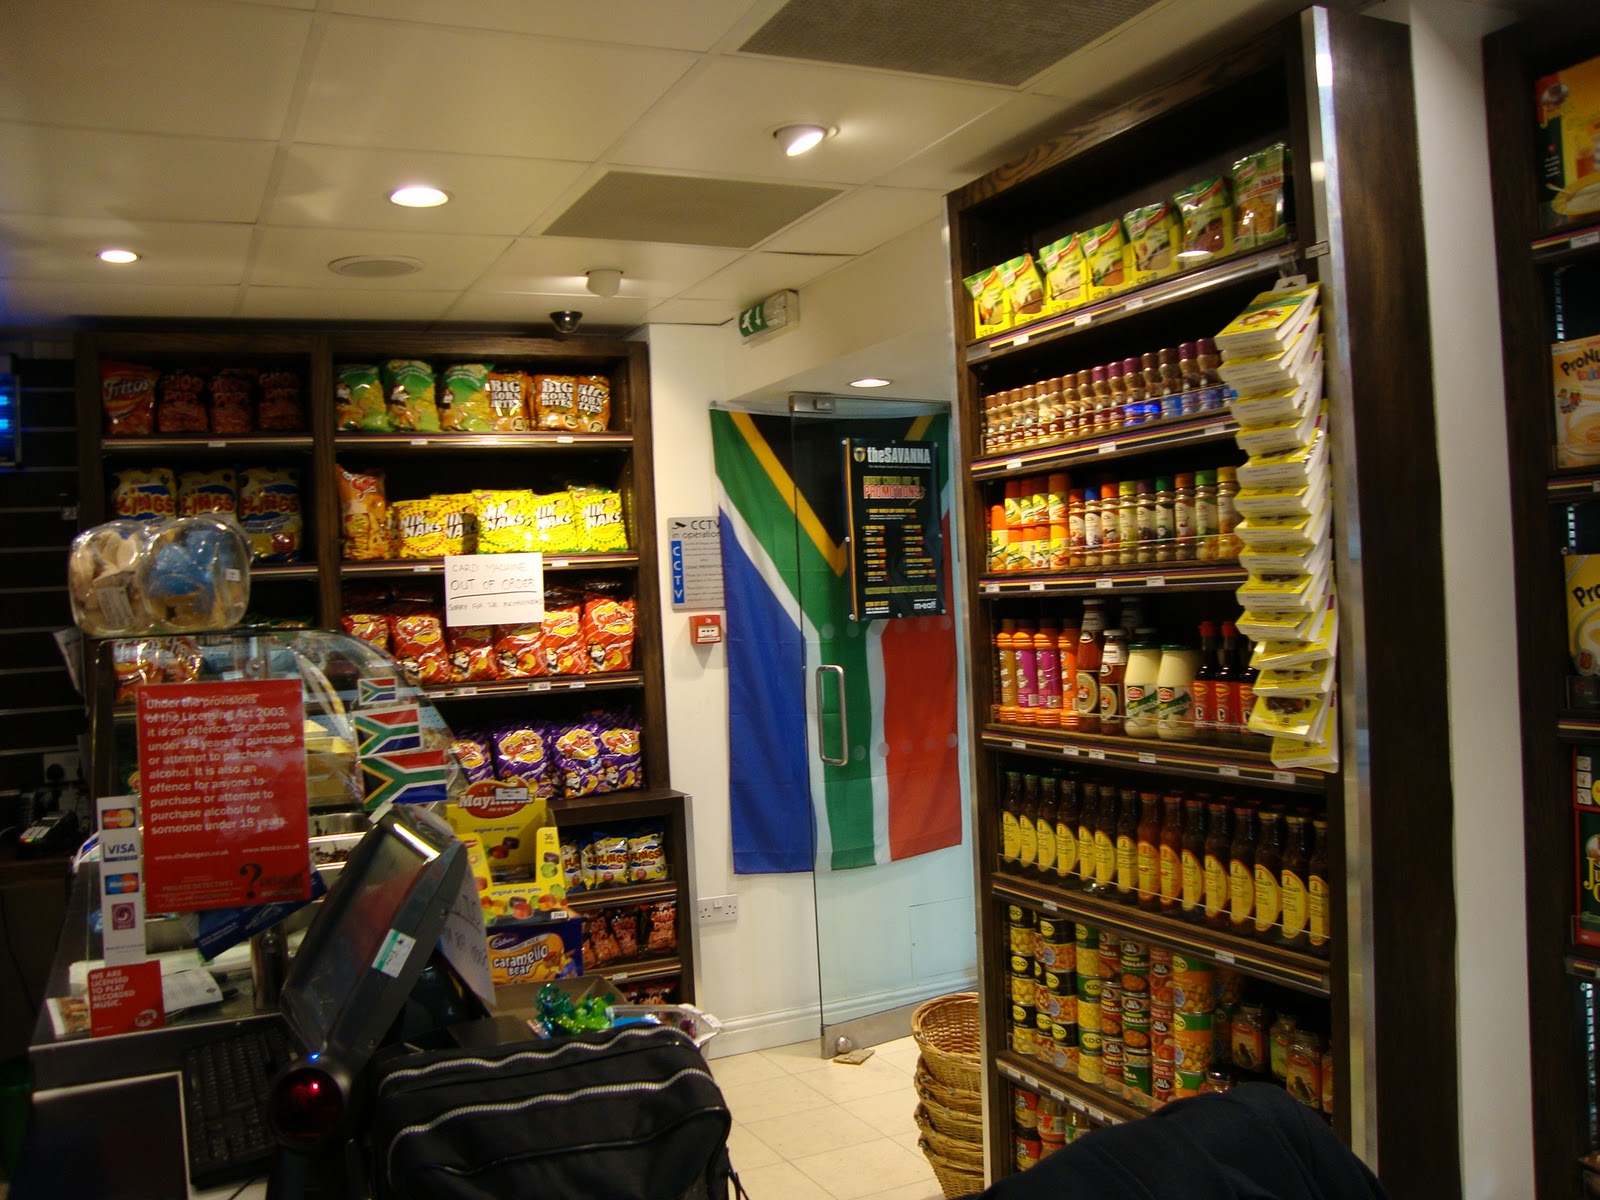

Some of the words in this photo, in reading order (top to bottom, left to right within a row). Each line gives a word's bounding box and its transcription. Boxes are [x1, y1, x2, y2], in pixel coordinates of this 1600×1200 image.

[103, 378, 149, 400] Fritos
[490, 380, 521, 392] BIG
[541, 381, 573, 393] BIG
[541, 392, 573, 401] KORN
[541, 399, 573, 409] BITES
[485, 514, 525, 532] NAKS
[586, 512, 621, 529] NAKS
[404, 522, 442, 538] NAKS
[452, 564, 478, 572] CARD
[450, 579, 475, 590] OUT
[482, 580, 495, 590] OF
[502, 578, 534, 590] ORDER
[146, 697, 178, 709] Under
[236, 709, 253, 718] Act
[187, 724, 228, 735] offence
[249, 722, 290, 734] persons
[148, 740, 180, 751] under
[184, 740, 198, 749] 18
[200, 739, 230, 751] years
[233, 737, 244, 746] to
[246, 735, 294, 748] purchase
[149, 757, 159, 765] or
[163, 754, 206, 766] attempt
[209, 753, 220, 761] to
[223, 750, 272, 762] purchase
[195, 767, 203, 776] It
[205, 767, 215, 776] is
[218, 766, 240, 775] also
[243, 764, 256, 773] an
[149, 781, 191, 793] offence
[194, 779, 209, 790] for
[212, 777, 251, 790] anyone
[254, 776, 264, 785] to
[150, 793, 201, 808] purchase
[203, 795, 215, 803] or
[217, 791, 260, 803] attempt
[263, 790, 274, 799] to
[151, 807, 202, 822] purchase
[204, 806, 244, 817] alcohol
[246, 804, 261, 814] for
[151, 822, 202, 835] someone
[205, 819, 236, 831] under
[240, 818, 254, 828] 18
[108, 843, 136, 854] VISA
[493, 945, 548, 968] caramello
[90, 972, 104, 980] WE
[106, 969, 122, 978] ARE
[91, 976, 129, 987] LICENSED
[91, 987, 104, 995] TO
[105, 984, 125, 993] PLAY
[92, 990, 136, 1002] RECORDED
